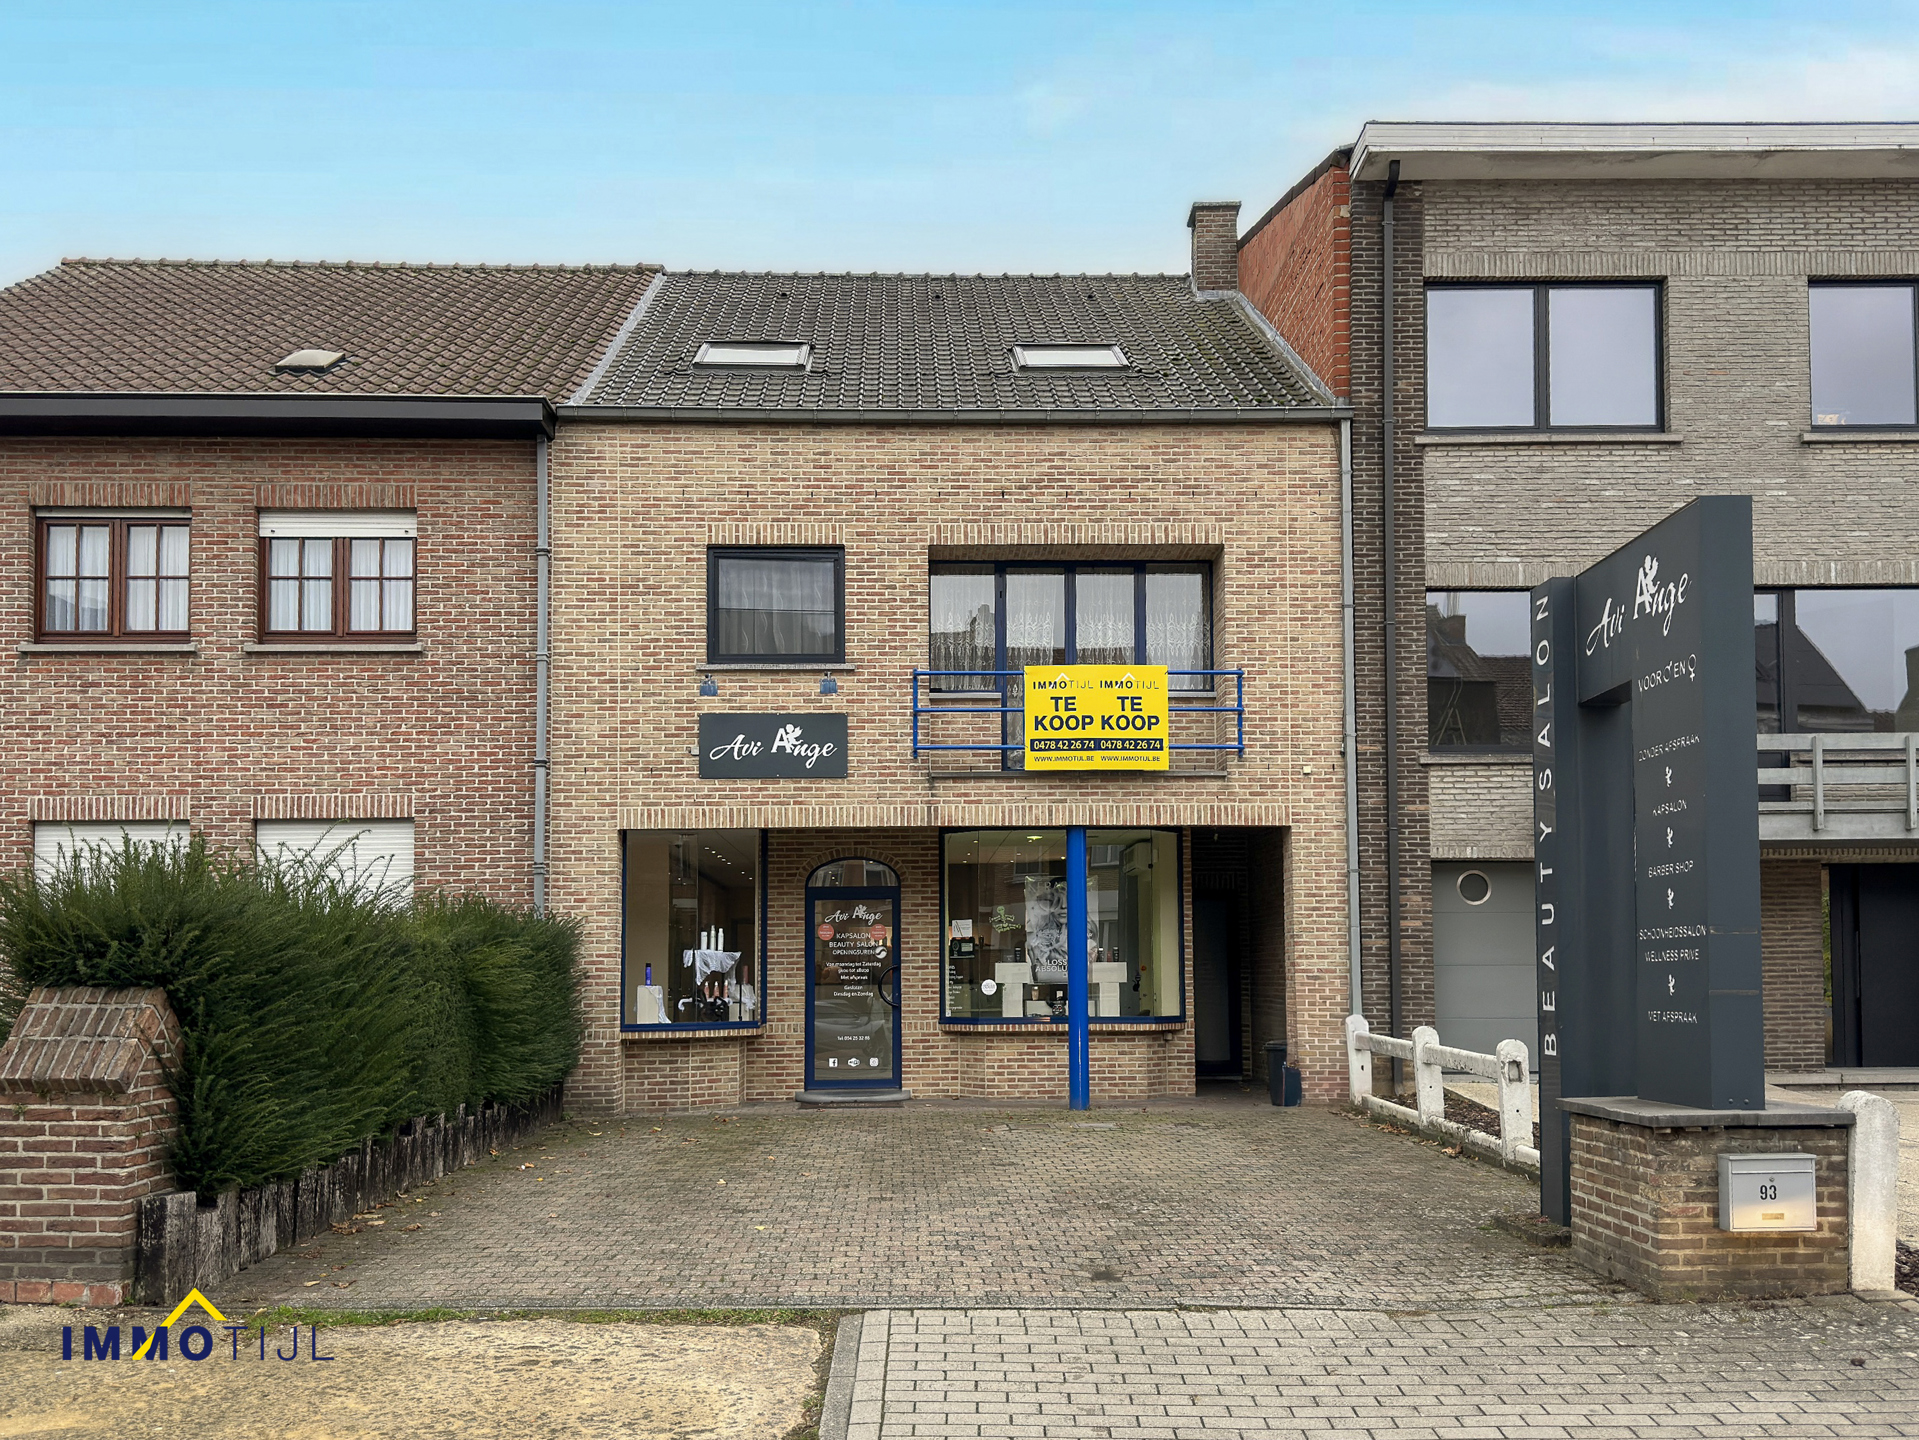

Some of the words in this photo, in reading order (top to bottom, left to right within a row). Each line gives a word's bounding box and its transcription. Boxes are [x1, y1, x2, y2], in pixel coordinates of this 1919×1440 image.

[1585, 597, 1627, 657] Avi
[1633, 566, 1692, 637] Ange
[1638, 670, 1662, 692] VOOR
[1673, 660, 1686, 678] EN
[1050, 696, 1077, 712] TE
[1116, 696, 1143, 712] TE
[1034, 714, 1094, 731] KOOP
[1101, 714, 1160, 731] KOOP
[709, 734, 764, 760] Avi
[771, 724, 838, 769] Ange
[1033, 740, 1056, 750] 0478
[1057, 740, 1069, 750] 42
[1070, 740, 1082, 750] 26
[1083, 740, 1095, 750] 74
[1100, 740, 1122, 750] 0478
[1124, 740, 1135, 750] 42
[1136, 740, 1148, 750] 26
[1149, 740, 1161, 750] 74
[1639, 744, 1664, 761] ZONDER
[1665, 734, 1700, 752] AFSPRAAK
[1653, 799, 1687, 816] KAPSALON
[1648, 863, 1674, 878] BARBER
[1675, 860, 1694, 874] SHOP
[824, 909, 850, 923] Avi
[852, 904, 883, 925] Ange
[1639, 925, 1706, 940] SCHOONHEIDSSALON
[1645, 949, 1678, 962] WELLNESS
[1662, 1011, 1698, 1024] AFSPRAAK
[1760, 1184, 1777, 1200] 93
